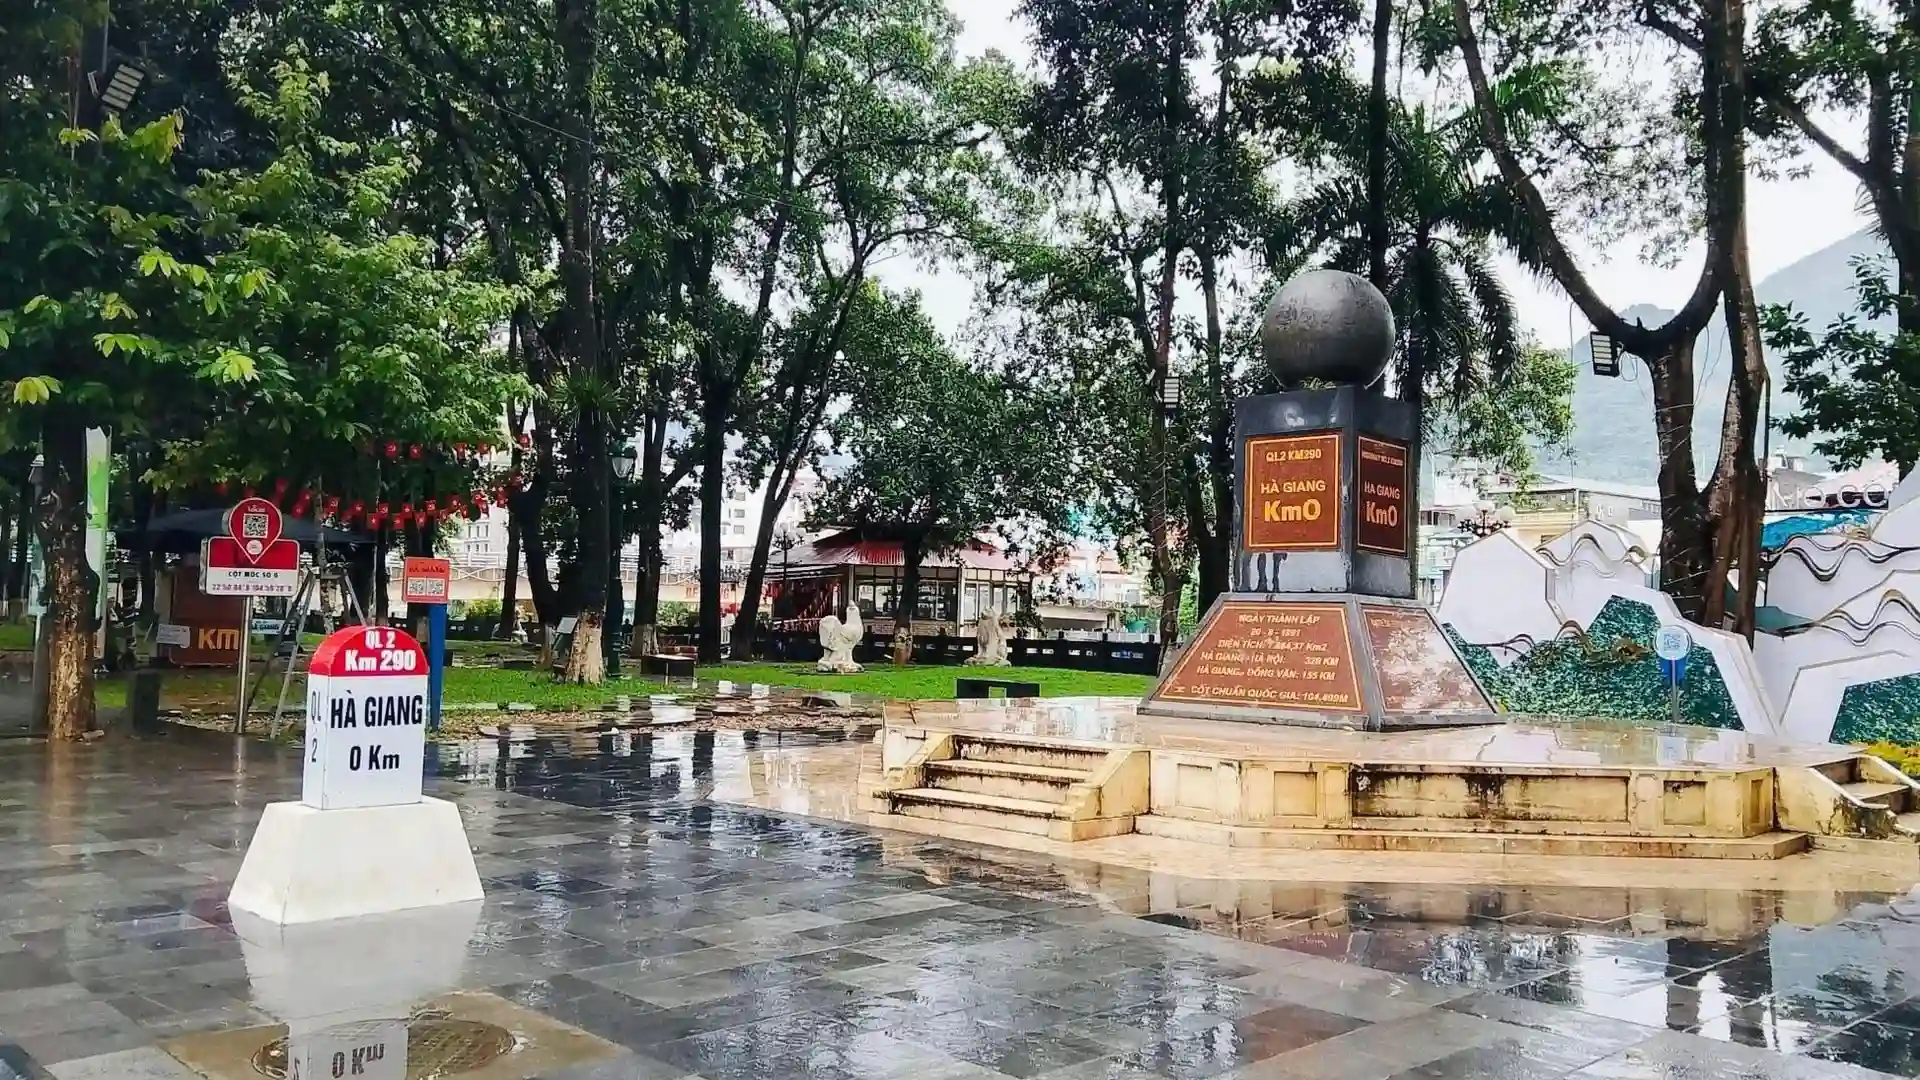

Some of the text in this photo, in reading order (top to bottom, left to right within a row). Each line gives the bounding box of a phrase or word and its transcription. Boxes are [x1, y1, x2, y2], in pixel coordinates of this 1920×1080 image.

[1266, 450, 1286, 462] QL2
[1261, 479, 1326, 494] HÀ GIANG
[1376, 484, 1400, 500] GIANG
[365, 630, 396, 650] QL 2
[345, 649, 417, 671] Km 290
[331, 690, 423, 728] HÀ GIANG
[349, 745, 400, 771] 0 Km
